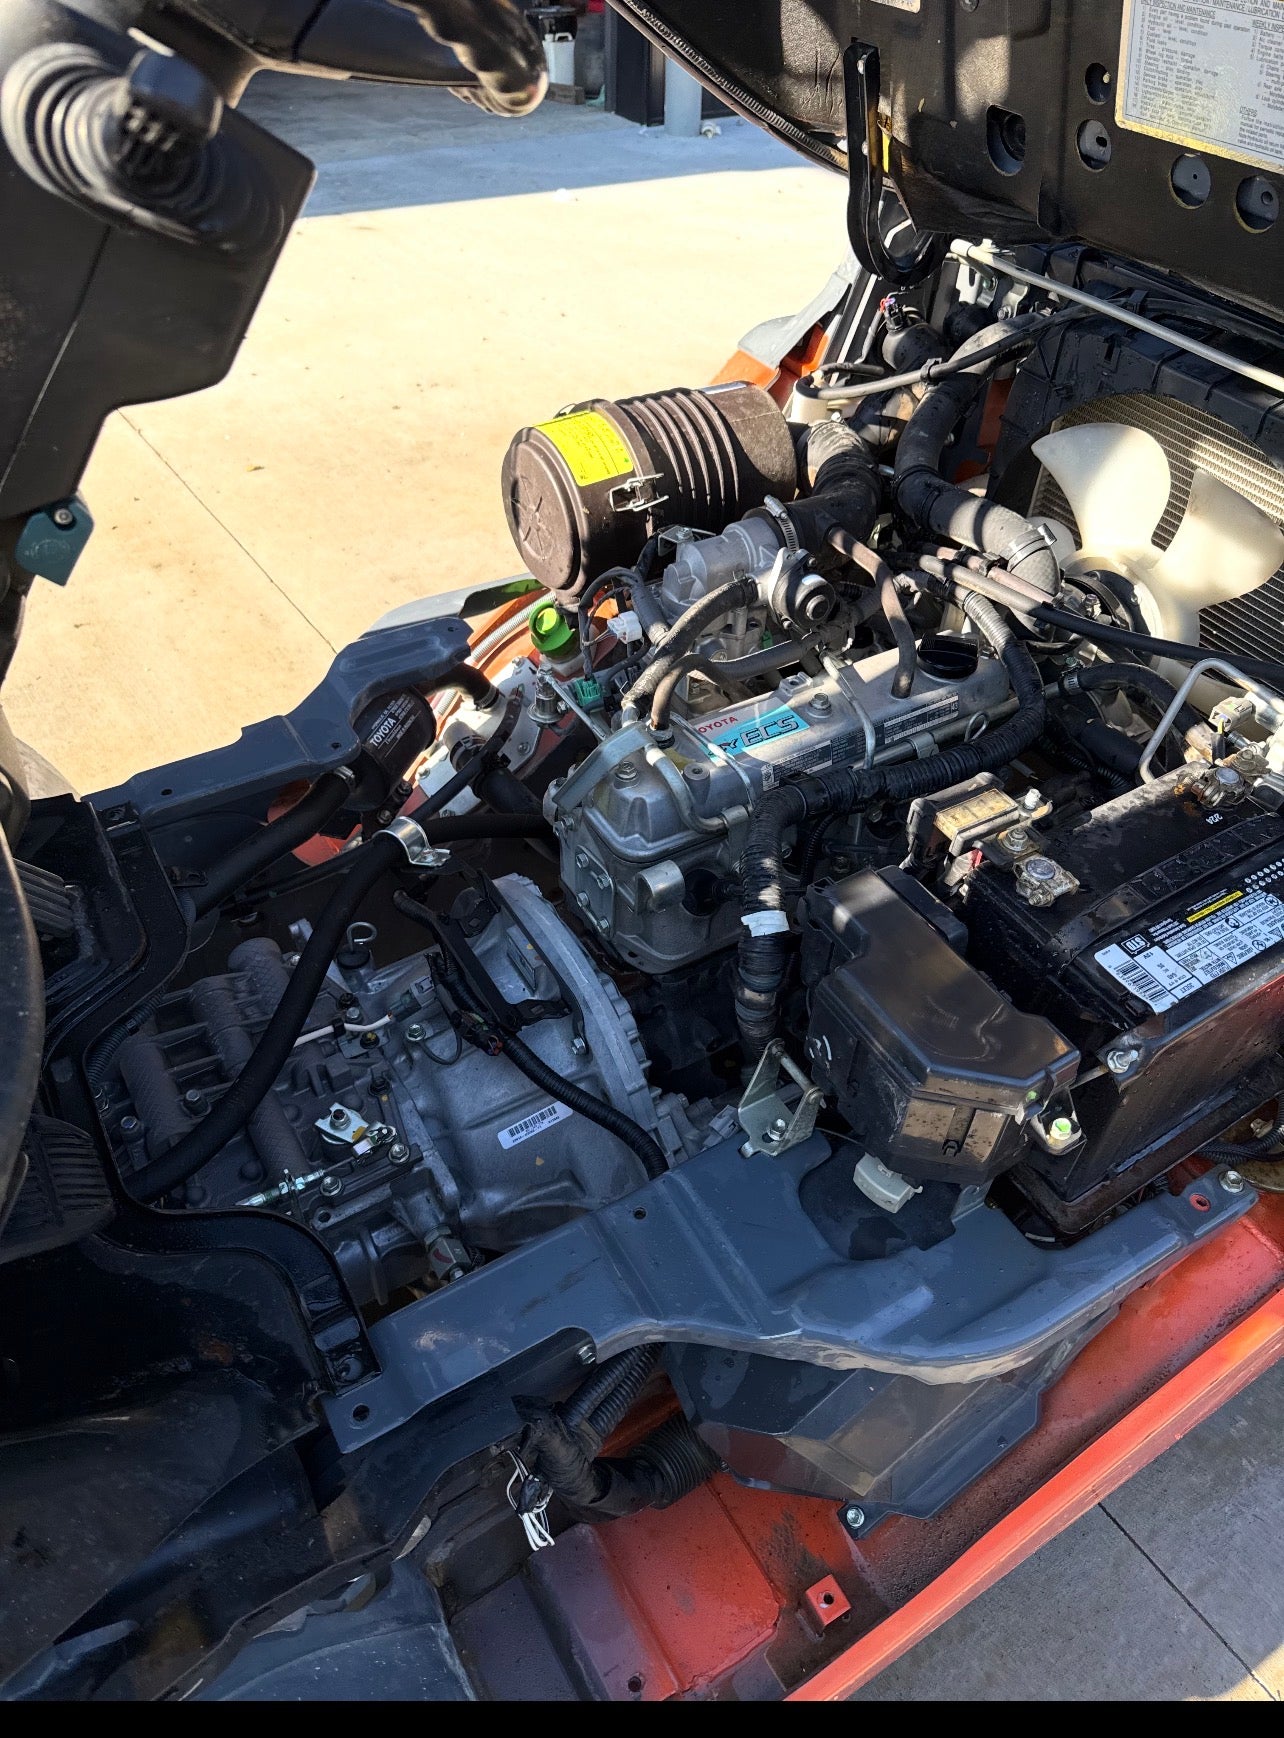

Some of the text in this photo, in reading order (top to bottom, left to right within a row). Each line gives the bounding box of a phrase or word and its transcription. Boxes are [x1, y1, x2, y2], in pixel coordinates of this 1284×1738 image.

[370, 718, 396, 746] TOYOTA
[698, 716, 737, 734] OYOTA
[741, 715, 799, 746] ECS
